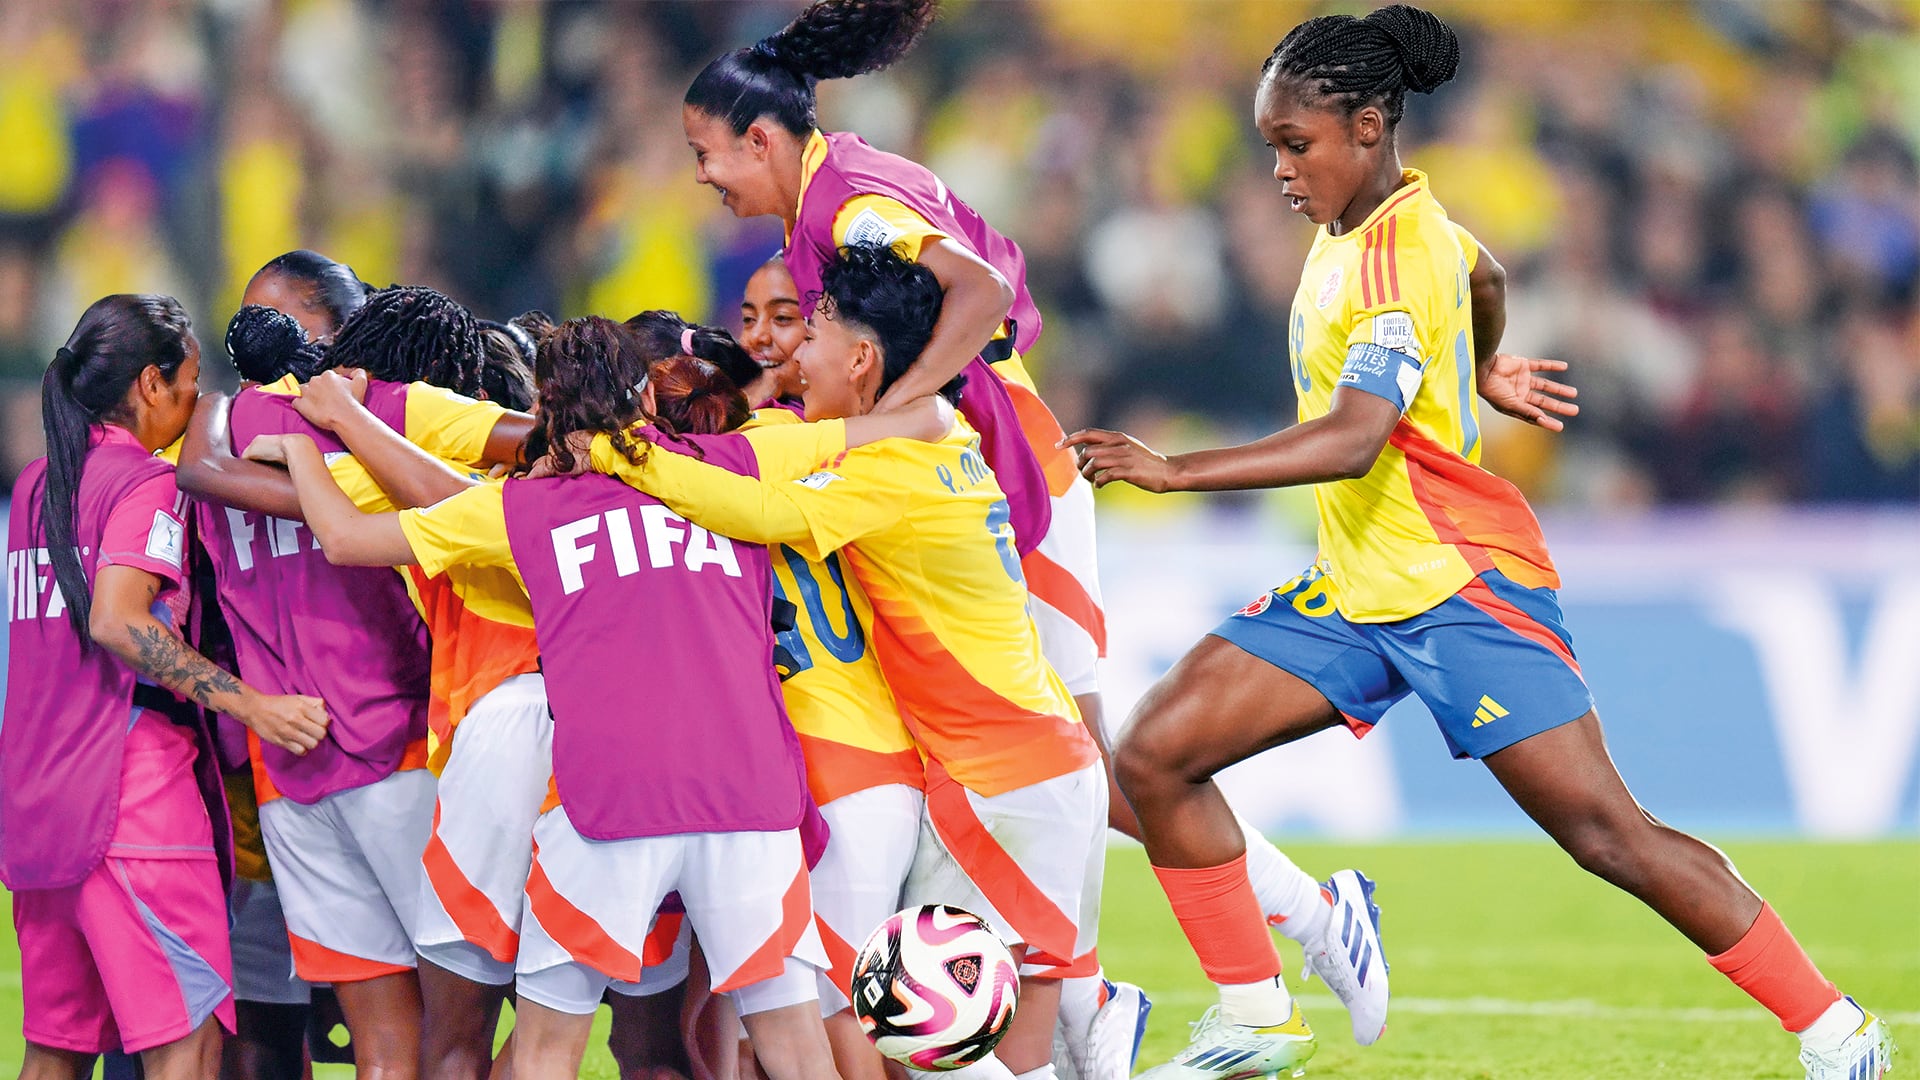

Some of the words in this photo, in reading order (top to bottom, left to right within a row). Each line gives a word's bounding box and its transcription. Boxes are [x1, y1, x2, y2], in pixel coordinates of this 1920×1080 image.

[1353, 361, 1387, 377] World
[936, 464, 964, 494] Y.
[224, 506, 322, 571] FIF
[550, 504, 743, 595] FIFA
